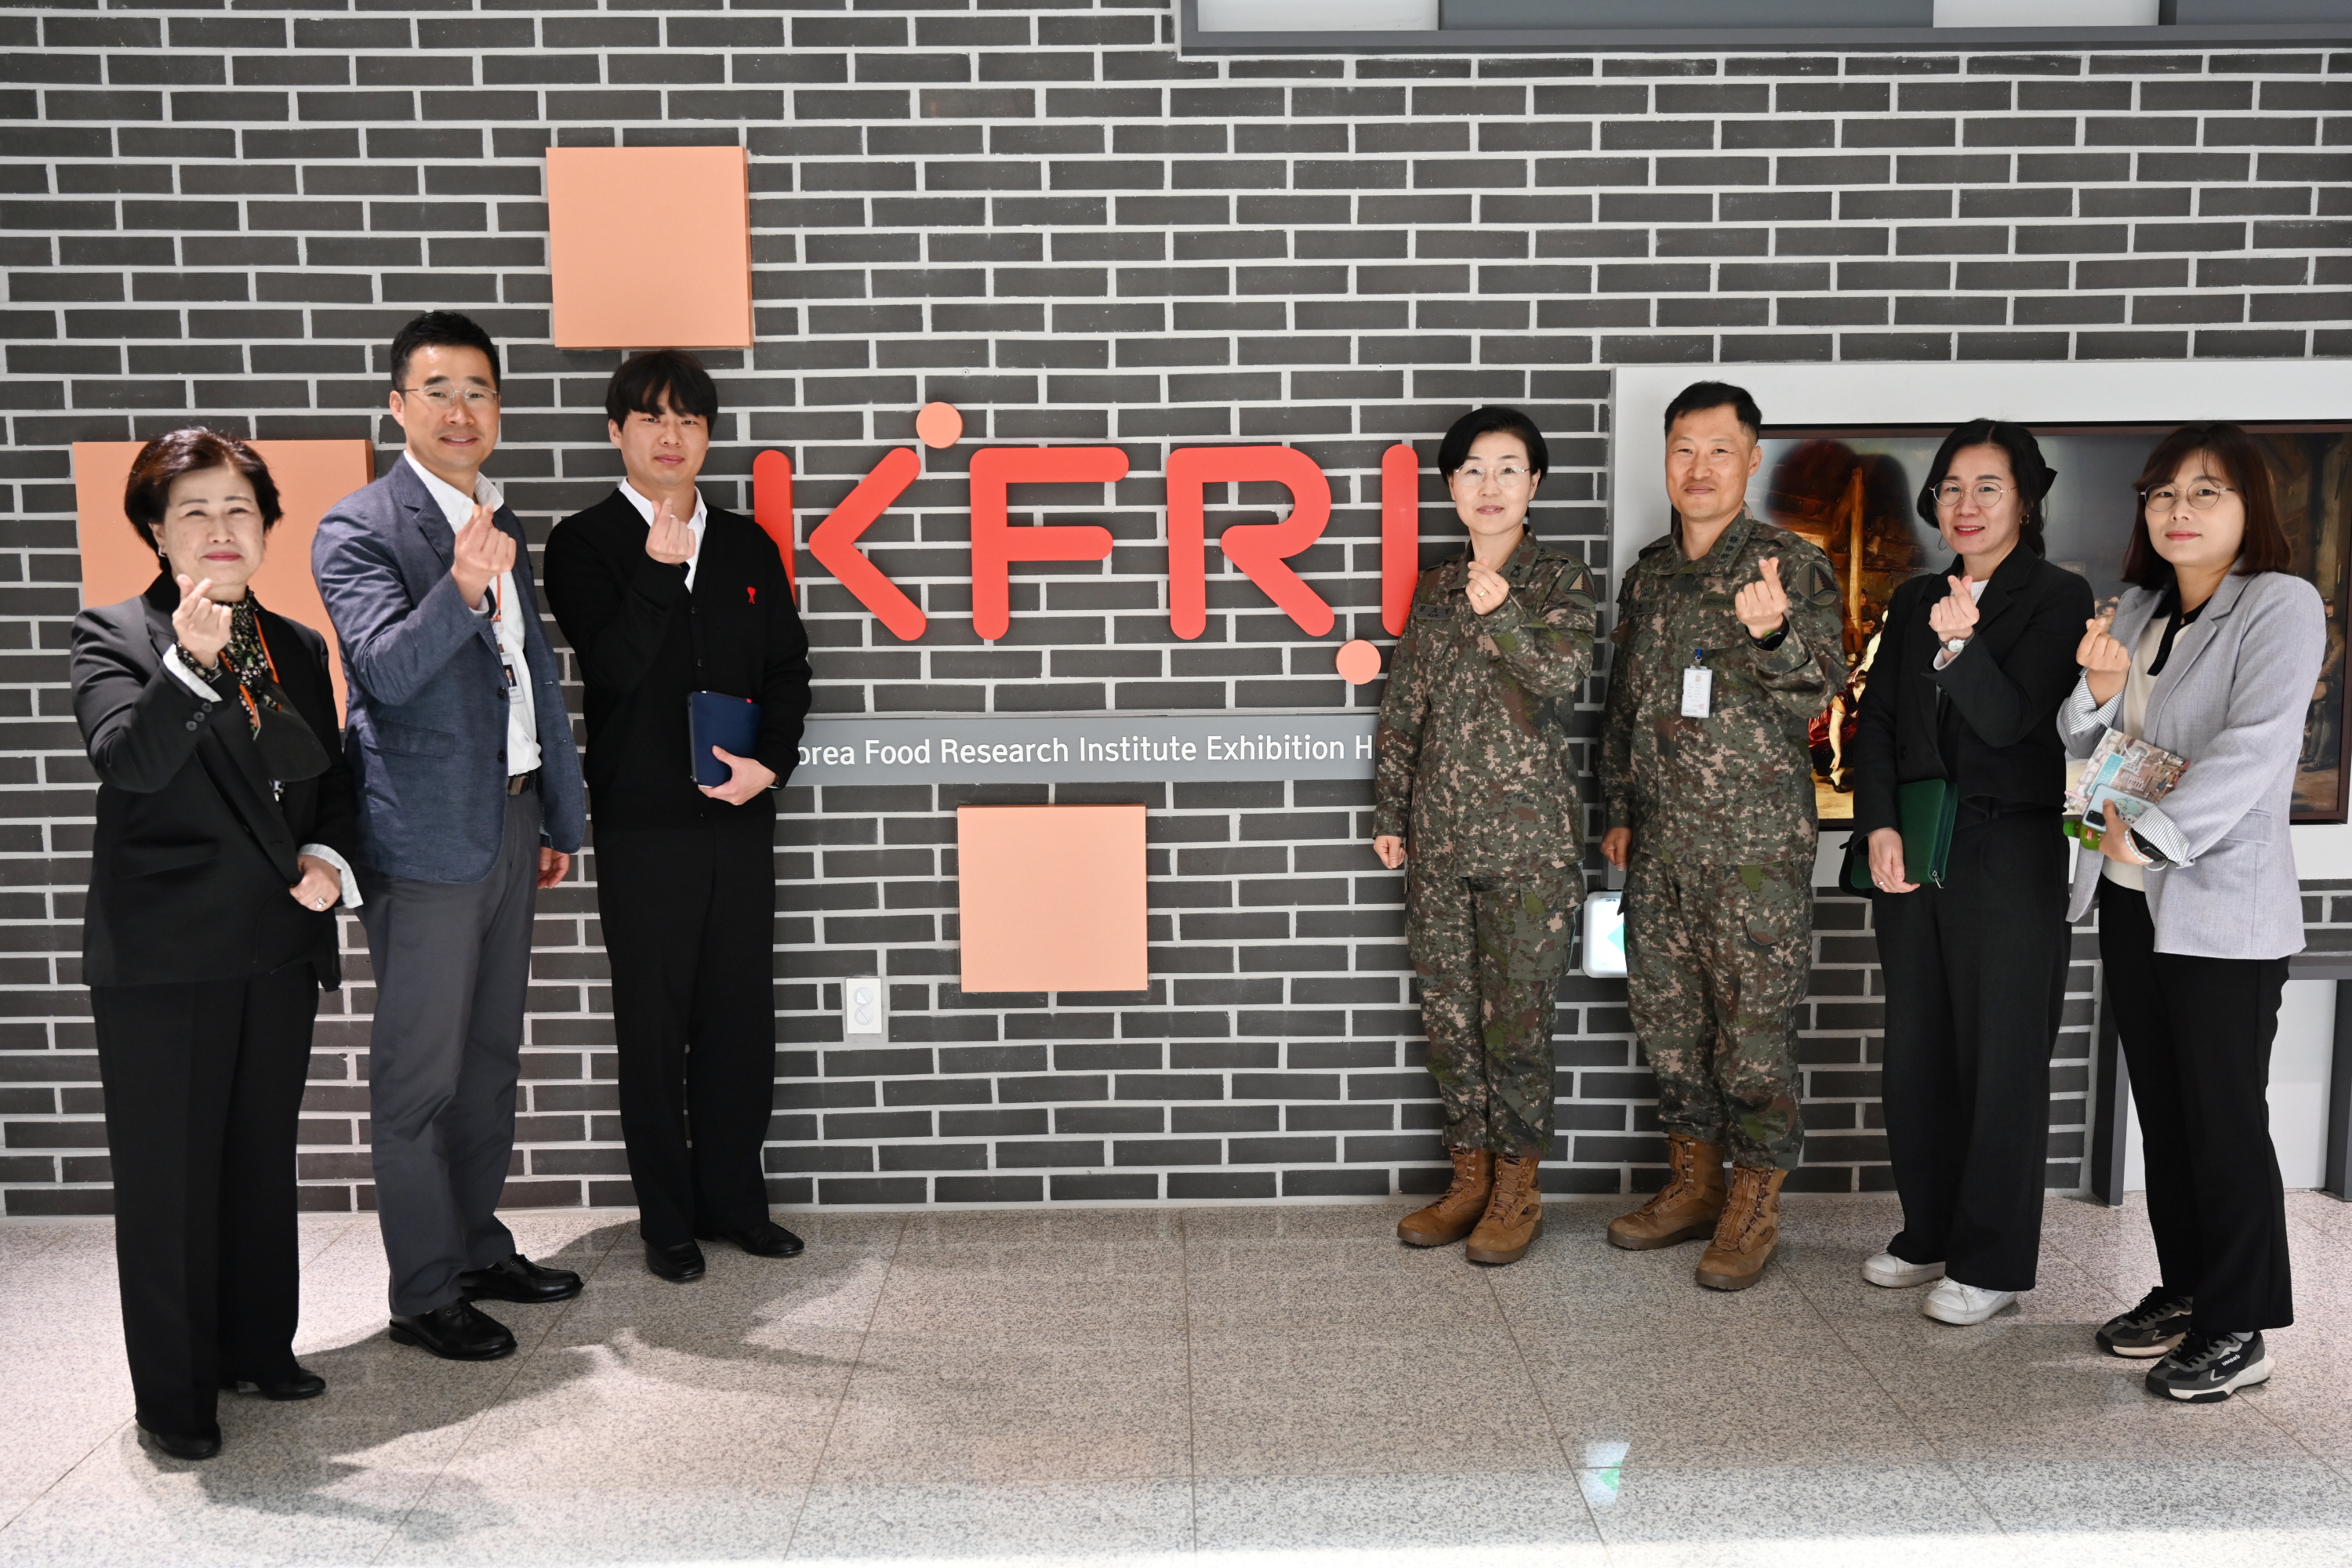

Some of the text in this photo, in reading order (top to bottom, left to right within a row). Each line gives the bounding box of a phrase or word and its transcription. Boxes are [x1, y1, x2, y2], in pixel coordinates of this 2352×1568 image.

[753, 443, 1418, 641] KFRI
[797, 745, 855, 765] orea
[865, 739, 931, 764] Food
[941, 737, 1069, 764] Research
[1080, 735, 1197, 762] Institute
[1207, 734, 1345, 760] Exhibition
